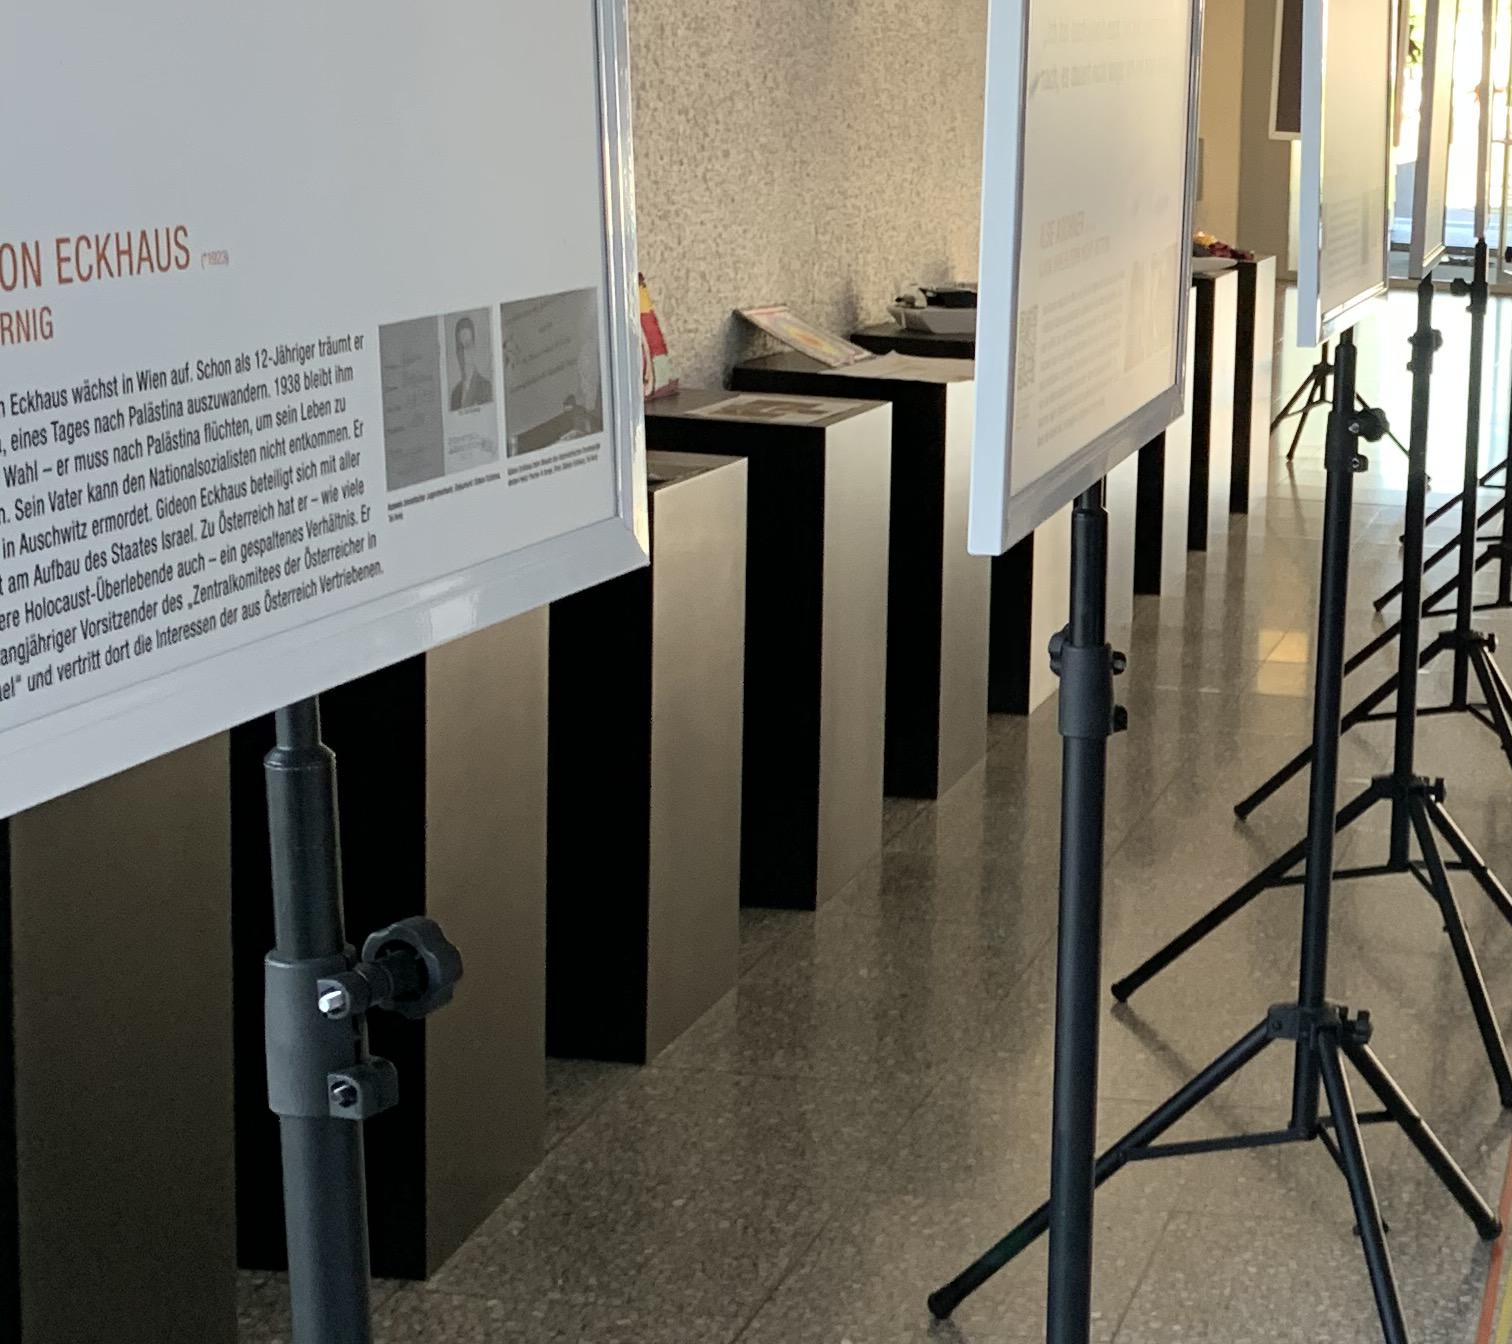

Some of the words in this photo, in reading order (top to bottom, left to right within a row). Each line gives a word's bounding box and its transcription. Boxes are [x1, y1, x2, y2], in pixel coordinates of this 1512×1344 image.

[0, 240, 42, 291] ON
[55, 225, 190, 284] ECKHAUS
[0, 306, 54, 346] RNIG
[10, 388, 68, 415] Eckhaus
[72, 376, 118, 404] wächst
[122, 372, 133, 394] in
[136, 369, 167, 391] Wien
[196, 357, 232, 381] Schon
[235, 353, 251, 374] als
[255, 342, 316, 369] 12-Jähriger
[319, 334, 352, 357] träumt
[354, 334, 364, 350] er
[3, 460, 38, 488] Wahl
[57, 458, 69, 477] er
[74, 451, 109, 472] muss
[113, 438, 143, 463] nach
[147, 427, 200, 457] Palästina
[204, 418, 253, 443] flüchten,
[256, 413, 272, 431] um
[276, 405, 298, 427] sein
[301, 399, 331, 421] Leben
[334, 397, 346, 413] zu
[11, 427, 47, 452] eines
[51, 419, 90, 445] Tages
[94, 409, 125, 433] nach
[129, 399, 184, 427] Palästina
[275, 373, 300, 397] 1938
[304, 367, 332, 391] bleibt
[335, 364, 353, 383] ihm
[2, 538, 15, 558] in
[19, 520, 87, 555] Auschwitz
[92, 503, 153, 536] ermordet.
[156, 492, 197, 519] Gideon
[200, 481, 247, 508] Eckhaus
[250, 466, 294, 495] beteiligt
[296, 458, 317, 481] sich
[320, 455, 336, 475] mit
[339, 451, 360, 470] aller
[15, 492, 45, 521] Sein
[48, 487, 83, 512] Vater
[88, 482, 119, 503] kann
[123, 473, 145, 494] den
[149, 447, 256, 489] Nationalsozialisten
[260, 438, 286, 460] nicht
[289, 425, 351, 454] entkommen.
[353, 418, 364, 438] Er
[8, 571, 29, 594] am
[33, 558, 80, 586] Aufbau
[85, 550, 108, 573] des
[111, 538, 158, 564] Staates
[161, 523, 197, 550] Israel.
[200, 519, 215, 539] Zu
[218, 505, 275, 536] Österreich
[277, 496, 295, 517] hat
[297, 494, 308, 512] er
[321, 485, 339, 505] wie
[341, 477, 365, 499] viele
[25, 566, 174, 624] Holocaust-Überlebende
[177, 552, 206, 578] auch
[220, 544, 237, 565] ein
[241, 526, 304, 564] gespaltenes
[305, 510, 358, 539] Verhältnis.
[361, 504, 371, 523] Er
[80, 600, 158, 641] Vorsitzender
[162, 591, 183, 616] des
[284, 556, 301, 576] der
[304, 535, 365, 570] Österreicher
[367, 531, 377, 549] in
[27, 664, 53, 692] und
[57, 650, 101, 682] vertritt
[105, 640, 130, 666] dort
[134, 635, 152, 656] die
[156, 615, 216, 649] Interessen
[220, 607, 237, 629] der
[242, 600, 261, 620] aus
[264, 579, 318, 613] Österreich
[319, 561, 384, 594] Vertriebenen.
